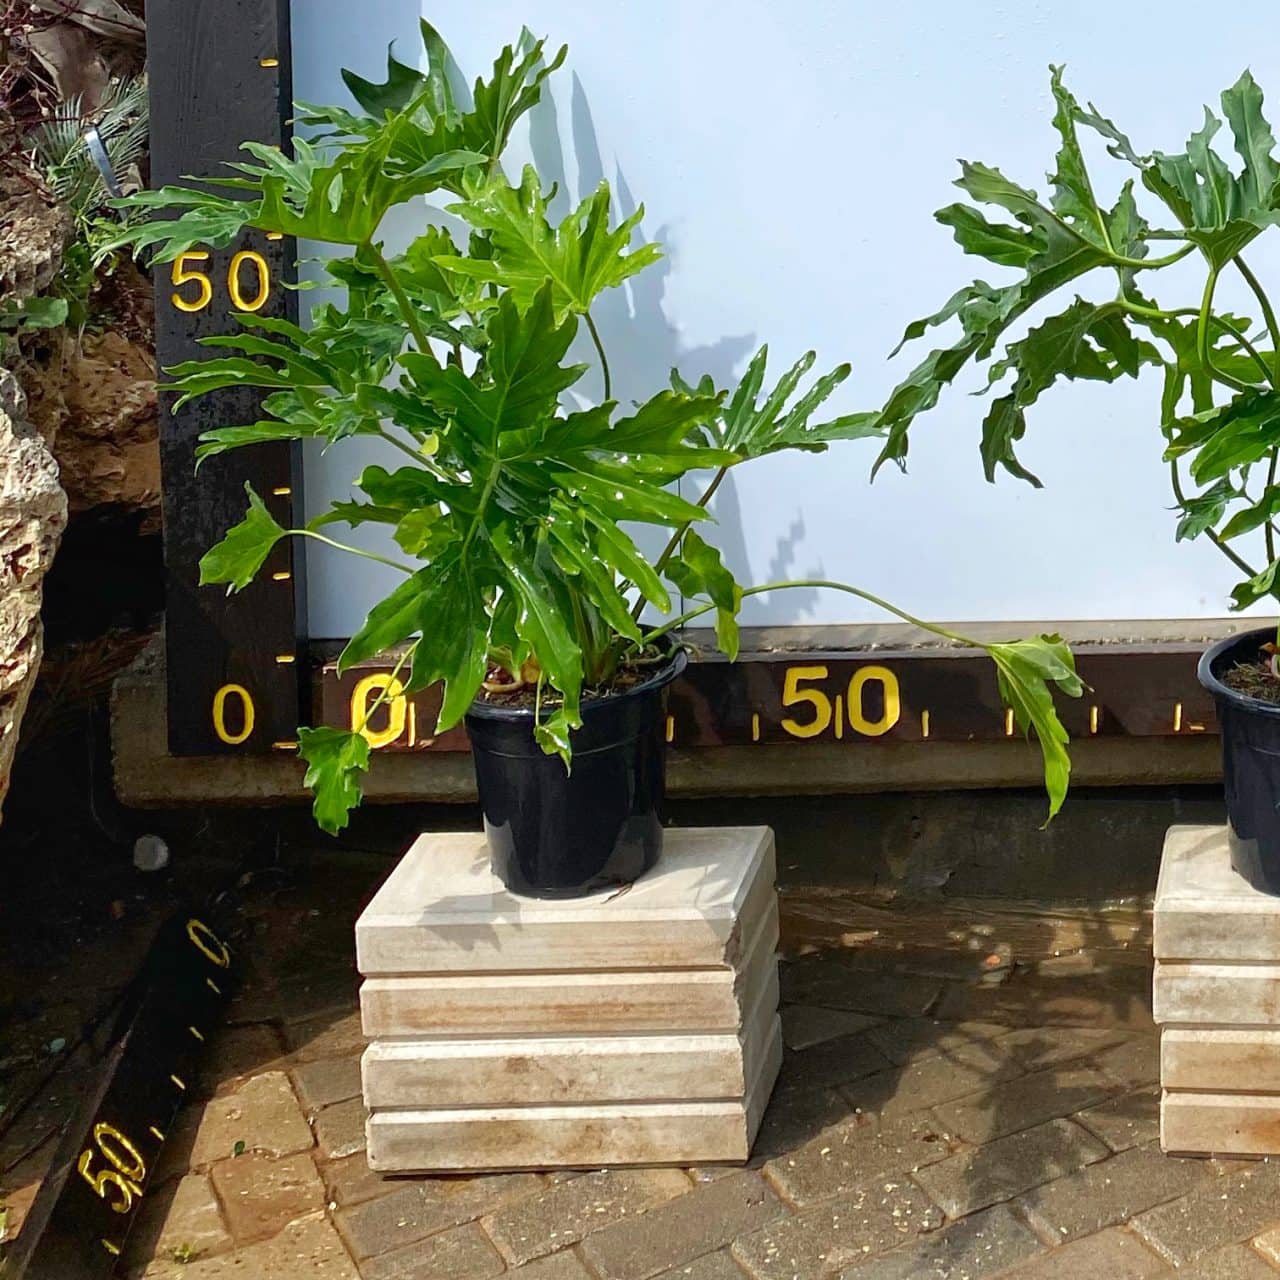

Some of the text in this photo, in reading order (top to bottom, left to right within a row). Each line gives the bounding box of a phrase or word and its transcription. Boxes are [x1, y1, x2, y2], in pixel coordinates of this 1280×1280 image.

[170, 250, 270, 313] 50
[211, 683, 255, 745] 0
[351, 672, 406, 750] 0
[781, 665, 900, 738] 50
[78, 1122, 146, 1214] 50
